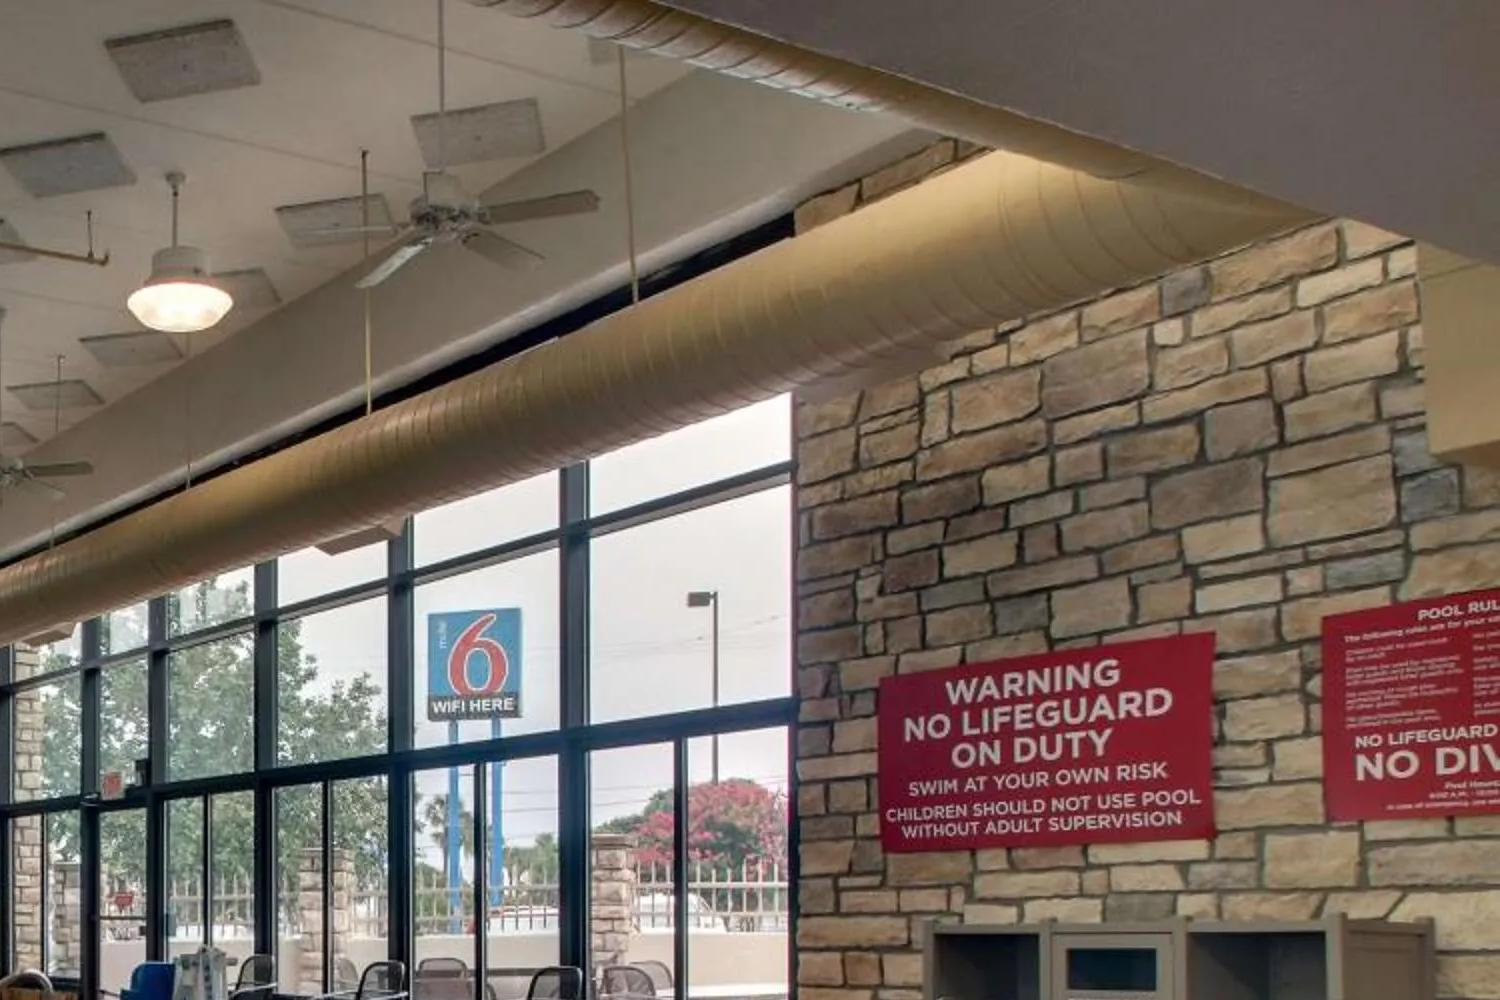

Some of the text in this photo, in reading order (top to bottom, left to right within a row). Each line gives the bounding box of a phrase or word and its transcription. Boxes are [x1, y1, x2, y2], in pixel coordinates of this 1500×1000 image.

[1418, 604, 1464, 620] POOL
[447, 613, 508, 696] 6
[945, 659, 1121, 705] WARNING
[432, 697, 515, 713] WIFI HERE
[904, 687, 1174, 742] NO LIFEGUARD
[951, 728, 1114, 769] ON DUTY
[1355, 723, 1498, 749] NO LIFEGUARD
[909, 761, 1169, 797] SWIM AT YOUR OWN RISK
[1356, 750, 1419, 781] NO
[886, 788, 1202, 823] CHILDREN SHOULD NOT USE POOL
[901, 811, 1182, 839] WITHOUT ADULT SUPERVISION
